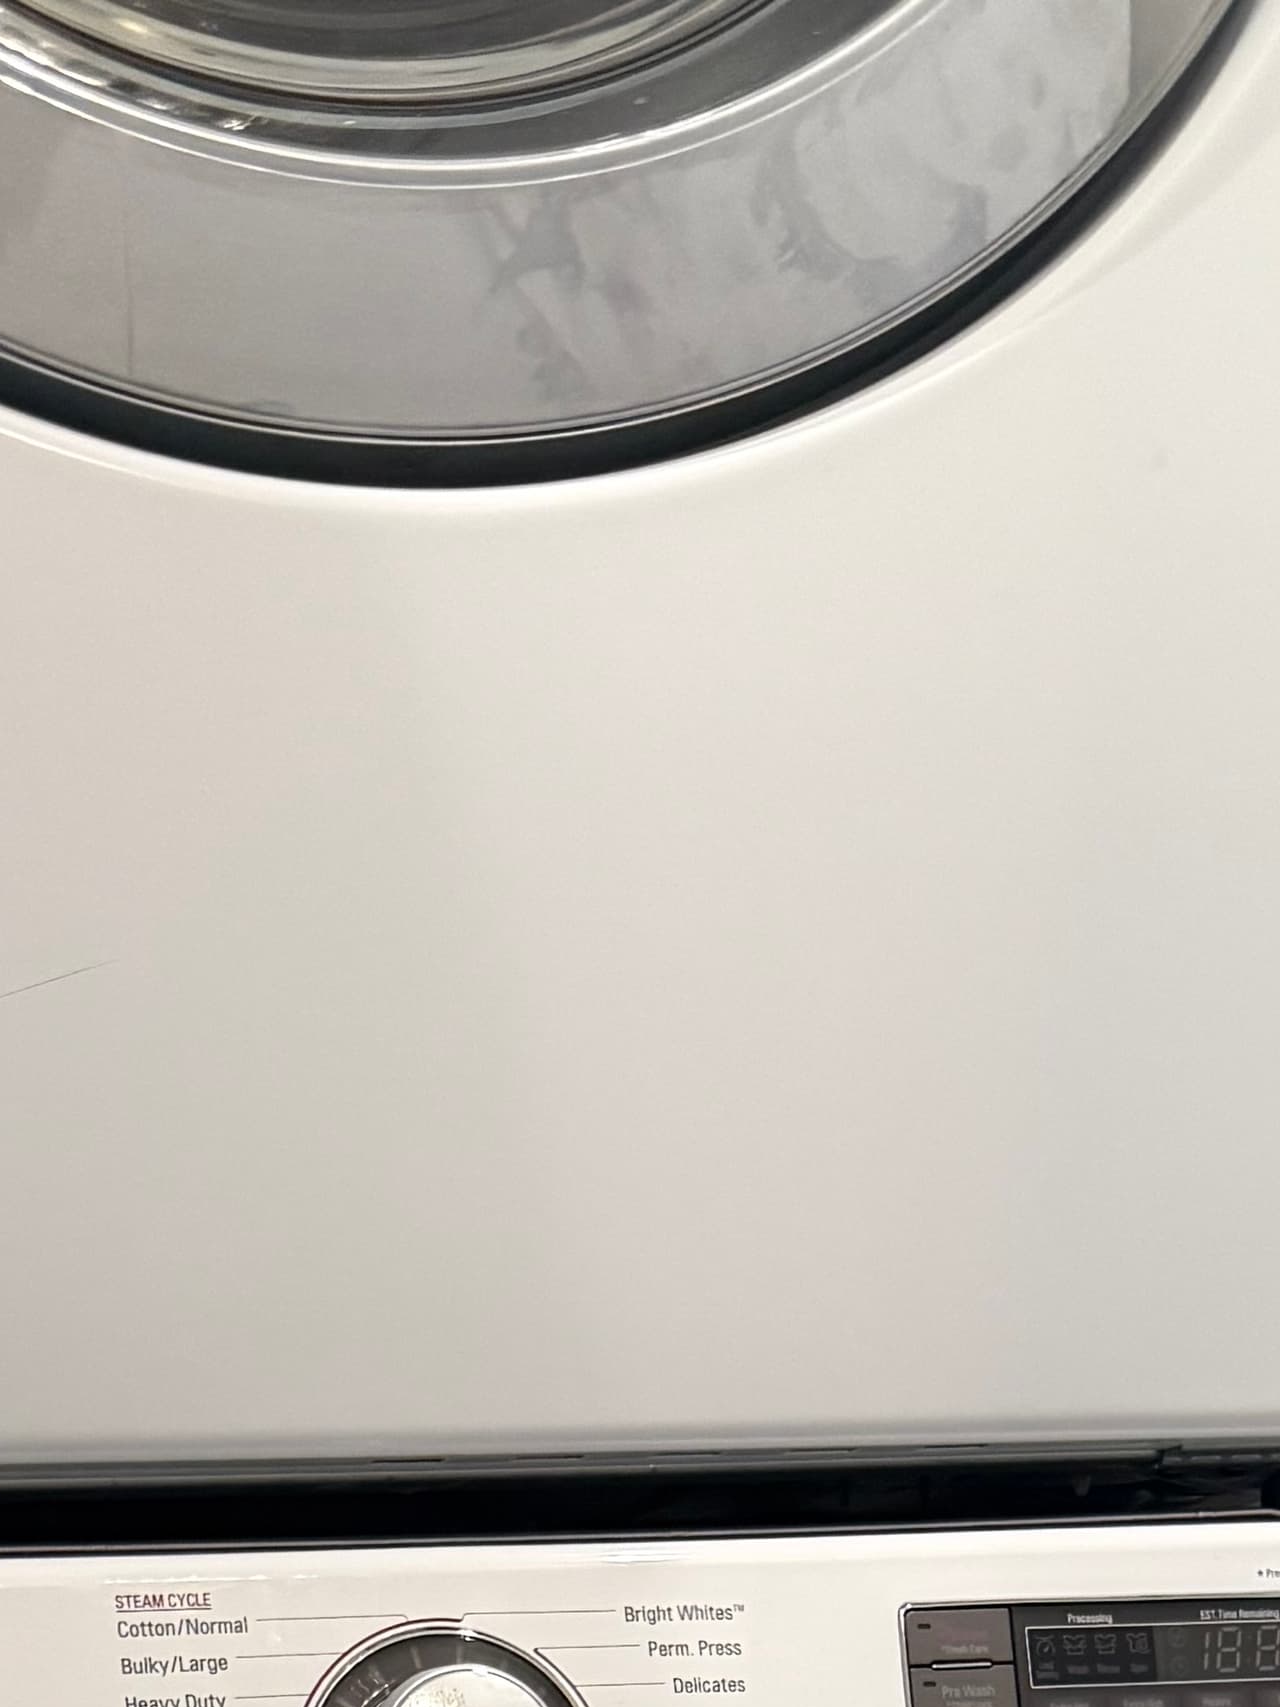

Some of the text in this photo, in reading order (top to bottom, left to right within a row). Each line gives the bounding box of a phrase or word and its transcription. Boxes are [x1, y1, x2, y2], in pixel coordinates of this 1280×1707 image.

[115, 1592, 212, 1609] STEAM CYCLE
[624, 1605, 673, 1625] Bright
[117, 1616, 248, 1638] Cotton/Normal
[648, 1640, 742, 1657] Perm. Press
[121, 1656, 228, 1677] Bulky/Large
[673, 1677, 746, 1693] Delicates
